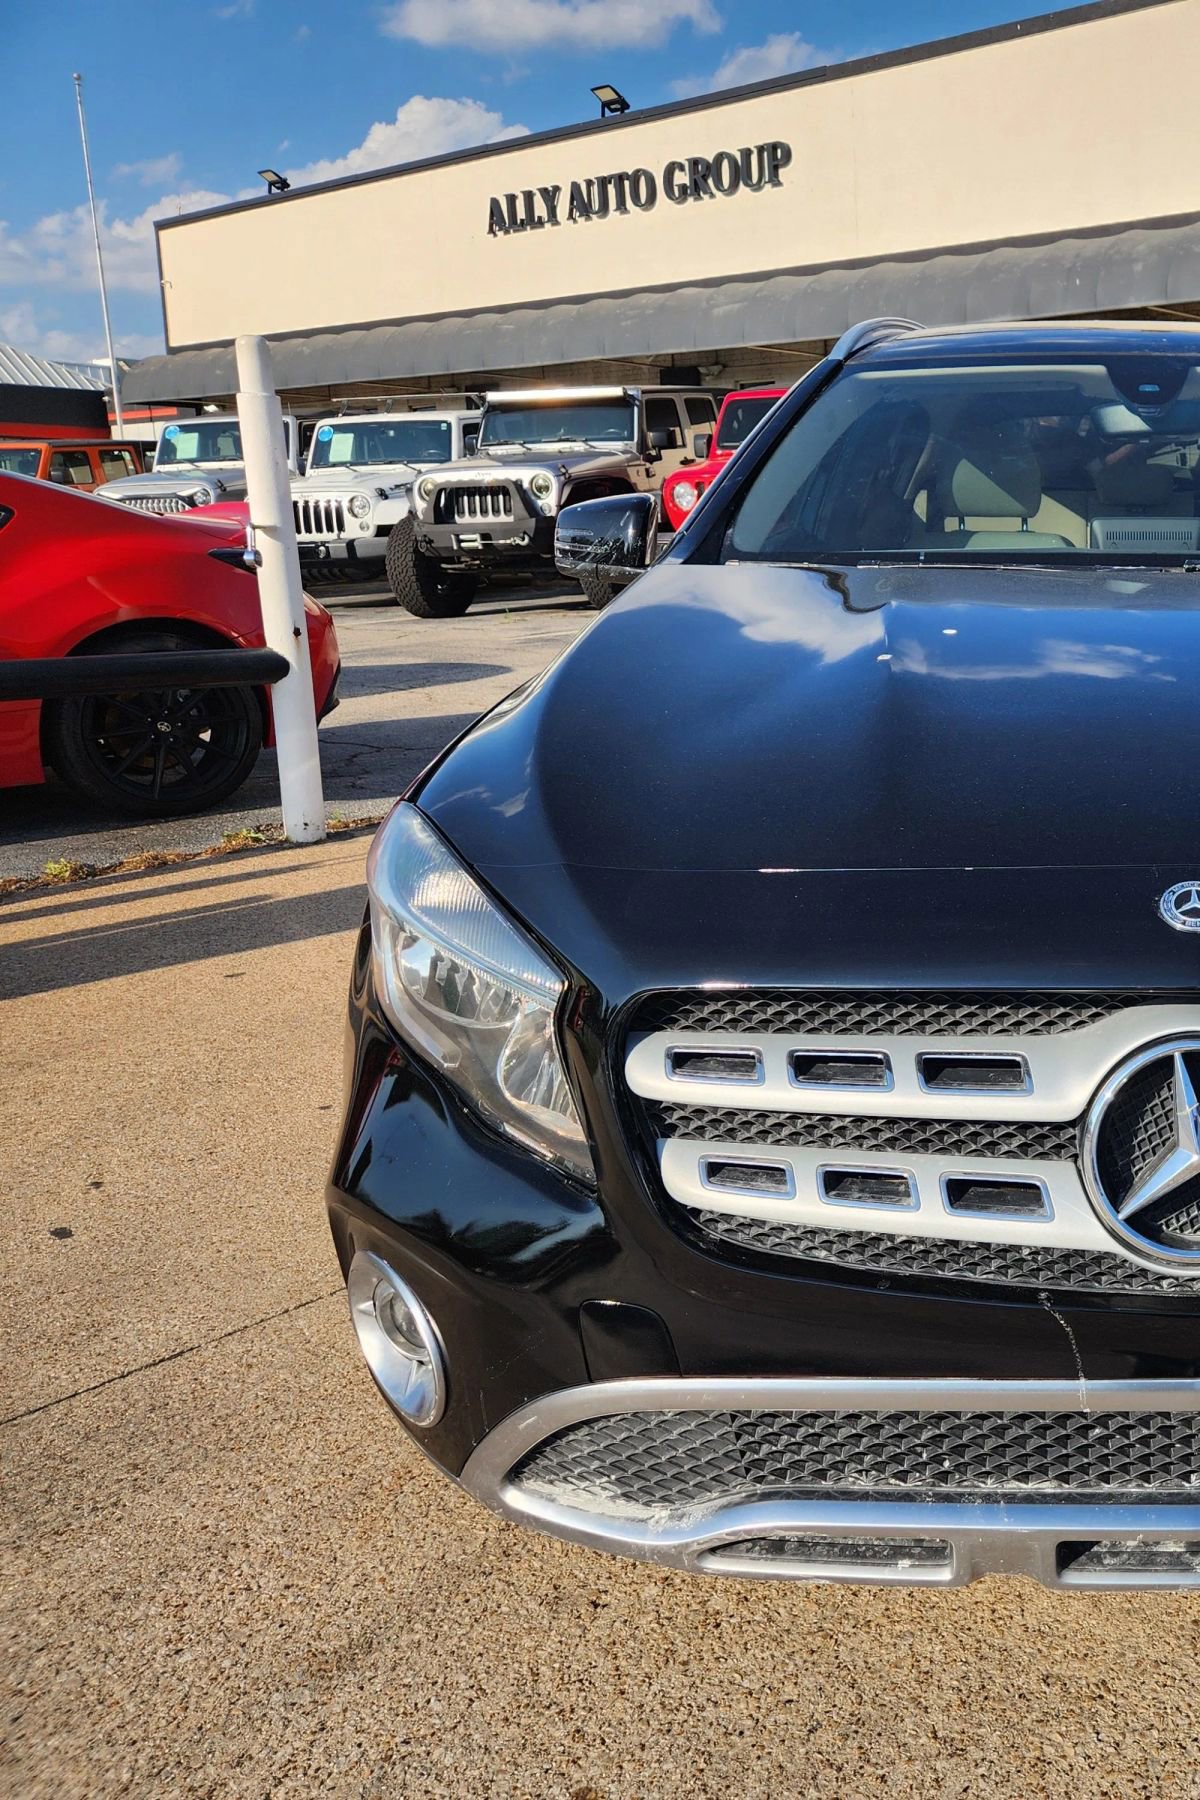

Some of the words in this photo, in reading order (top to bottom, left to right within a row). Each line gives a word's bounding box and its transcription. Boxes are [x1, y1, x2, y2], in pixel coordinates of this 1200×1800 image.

[487, 185, 562, 237] ALLY
[567, 168, 657, 223] AUTO
[663, 141, 792, 205] GROUP
